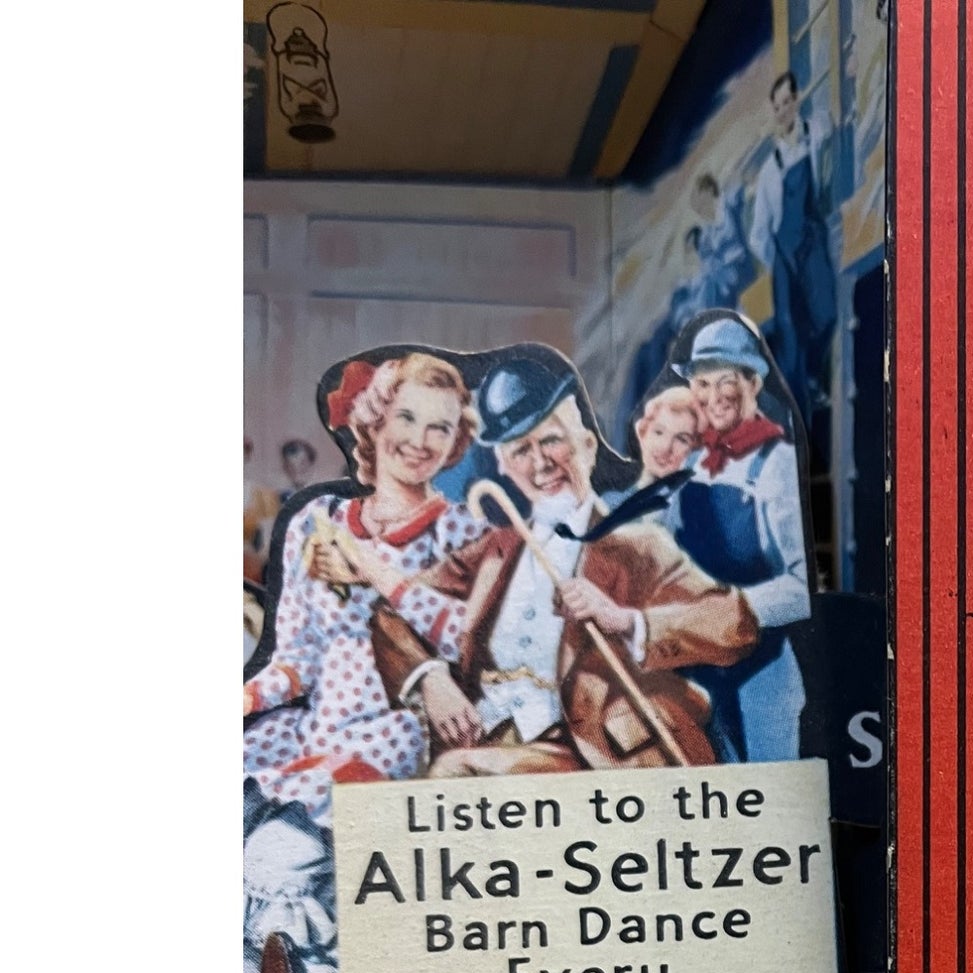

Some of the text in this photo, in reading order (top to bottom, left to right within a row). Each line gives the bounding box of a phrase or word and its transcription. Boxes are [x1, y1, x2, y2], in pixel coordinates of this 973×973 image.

[847, 710, 884, 769] S
[406, 781, 766, 833] Listen to the
[354, 838, 822, 905] Alka-Seltzer
[425, 906, 752, 953] Barn Dance
